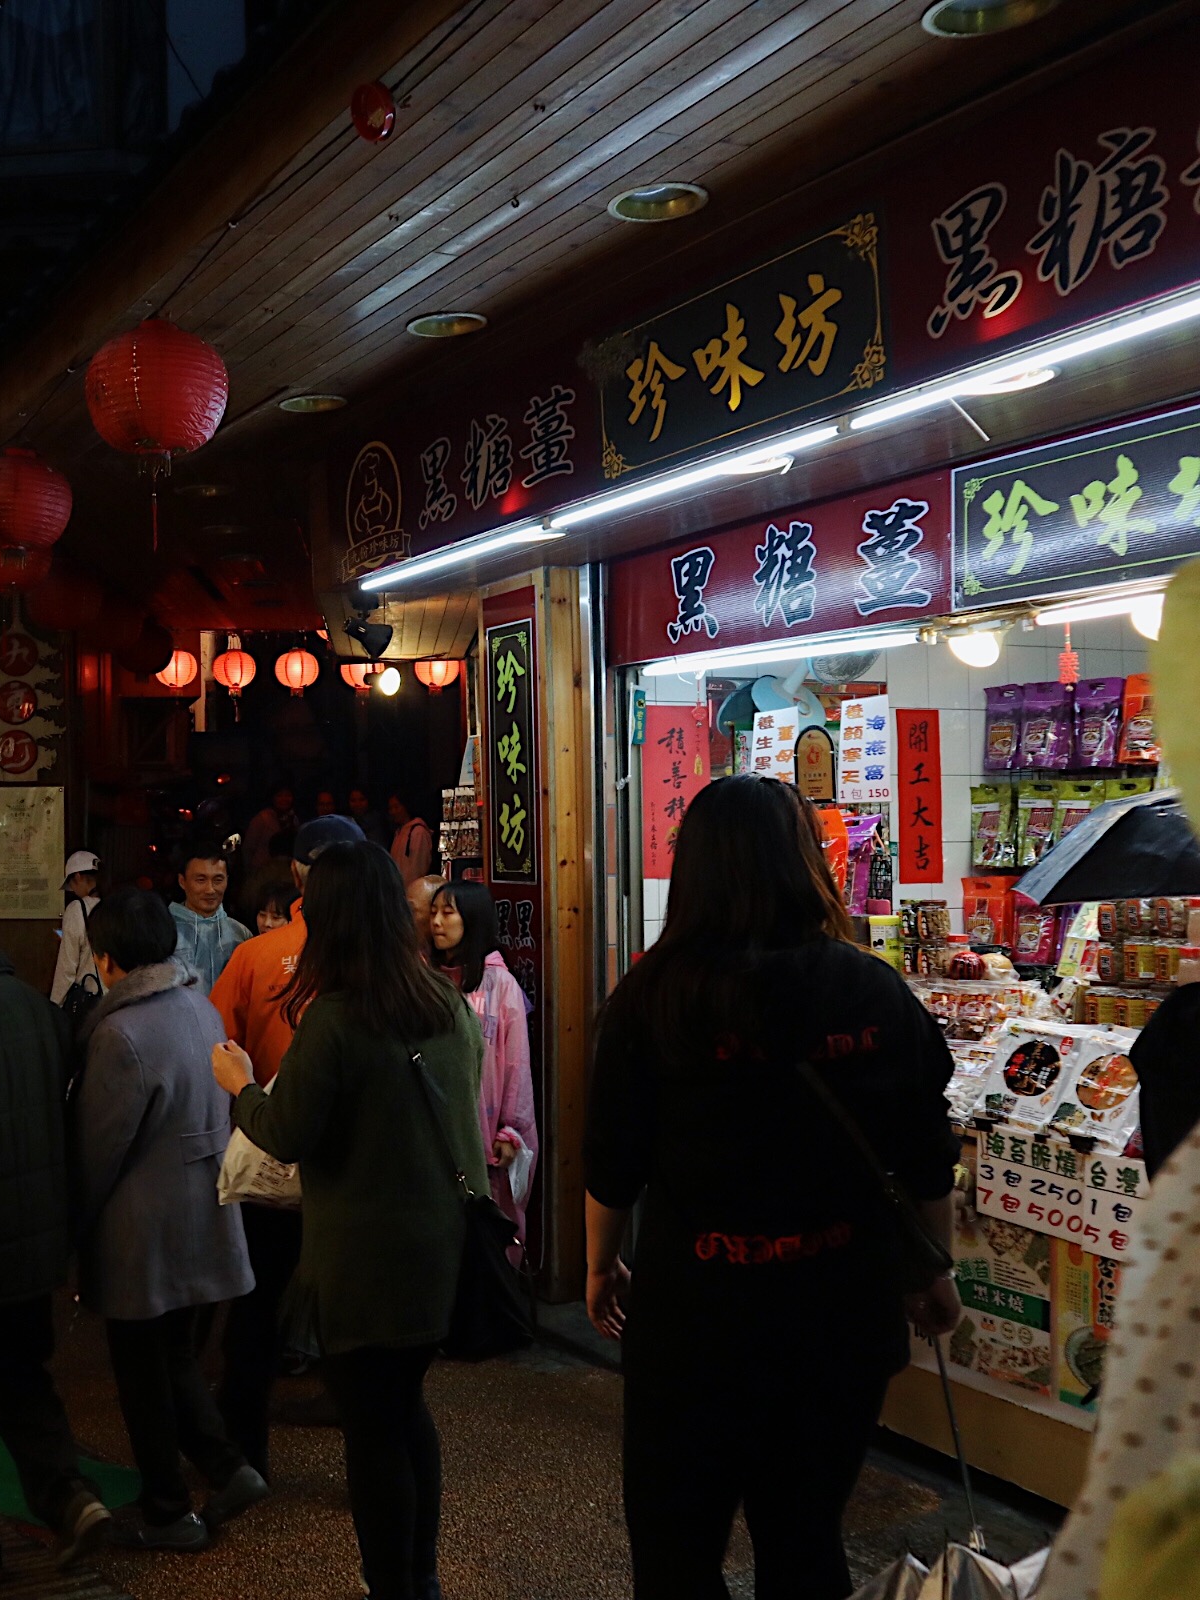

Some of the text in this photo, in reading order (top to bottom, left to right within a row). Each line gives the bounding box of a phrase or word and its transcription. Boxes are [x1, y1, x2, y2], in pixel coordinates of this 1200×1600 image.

[624, 273, 844, 443] 珍味坊
[418, 384, 577, 531] 黑糖薑
[353, 534, 400, 563] 九份珍味坊
[667, 497, 931, 643] 黑糖薑
[496, 649, 527, 856] 珍味坊
[864, 715, 888, 781] 海燕窩
[908, 720, 934, 870] 開工大吉
[987, 1131, 1077, 1178] 海苔脆燒
[1091, 1160, 1141, 1197] 台灣
[973, 1283, 1025, 1314] 黑米燒
